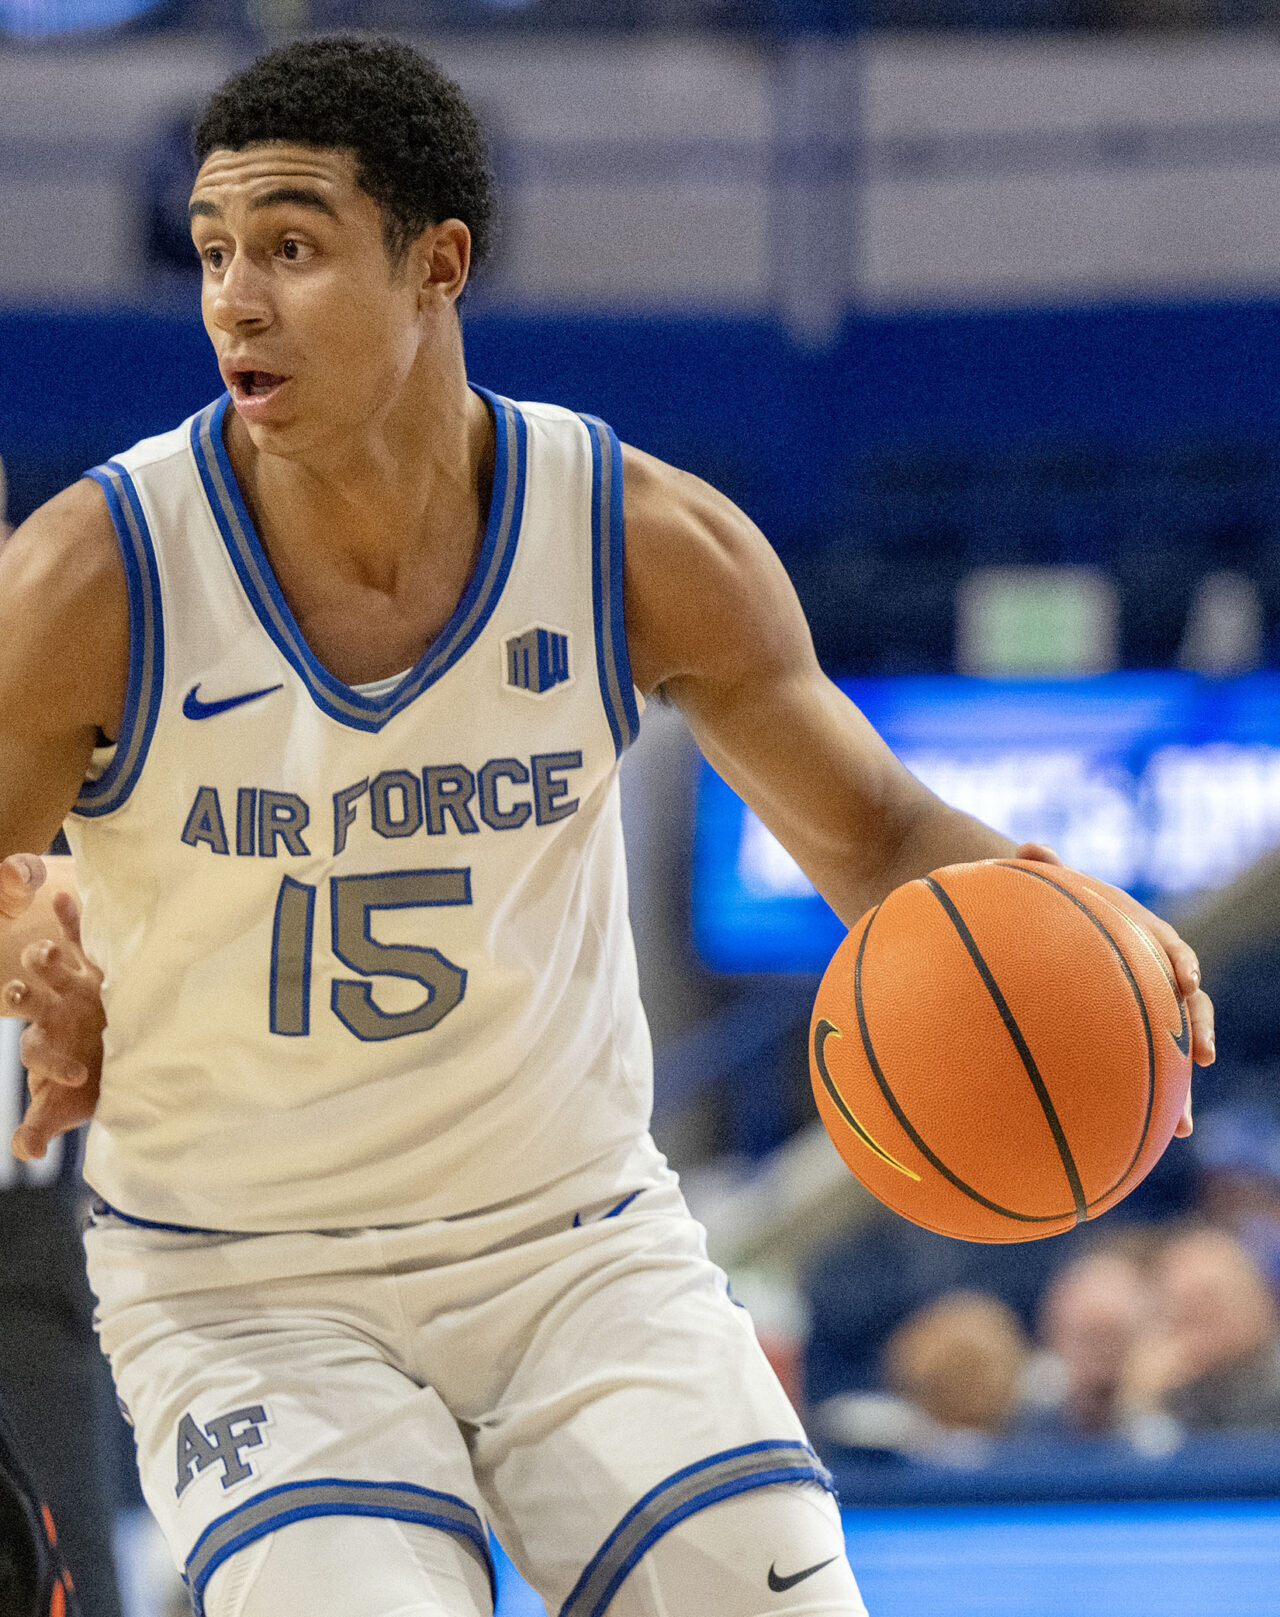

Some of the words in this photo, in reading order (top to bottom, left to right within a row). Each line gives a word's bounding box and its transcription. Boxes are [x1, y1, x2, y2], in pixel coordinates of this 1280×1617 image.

[180, 785, 312, 859] AIR
[332, 750, 583, 857] FORCE
[268, 866, 473, 1042] 15
[175, 1404, 268, 1499] AF
